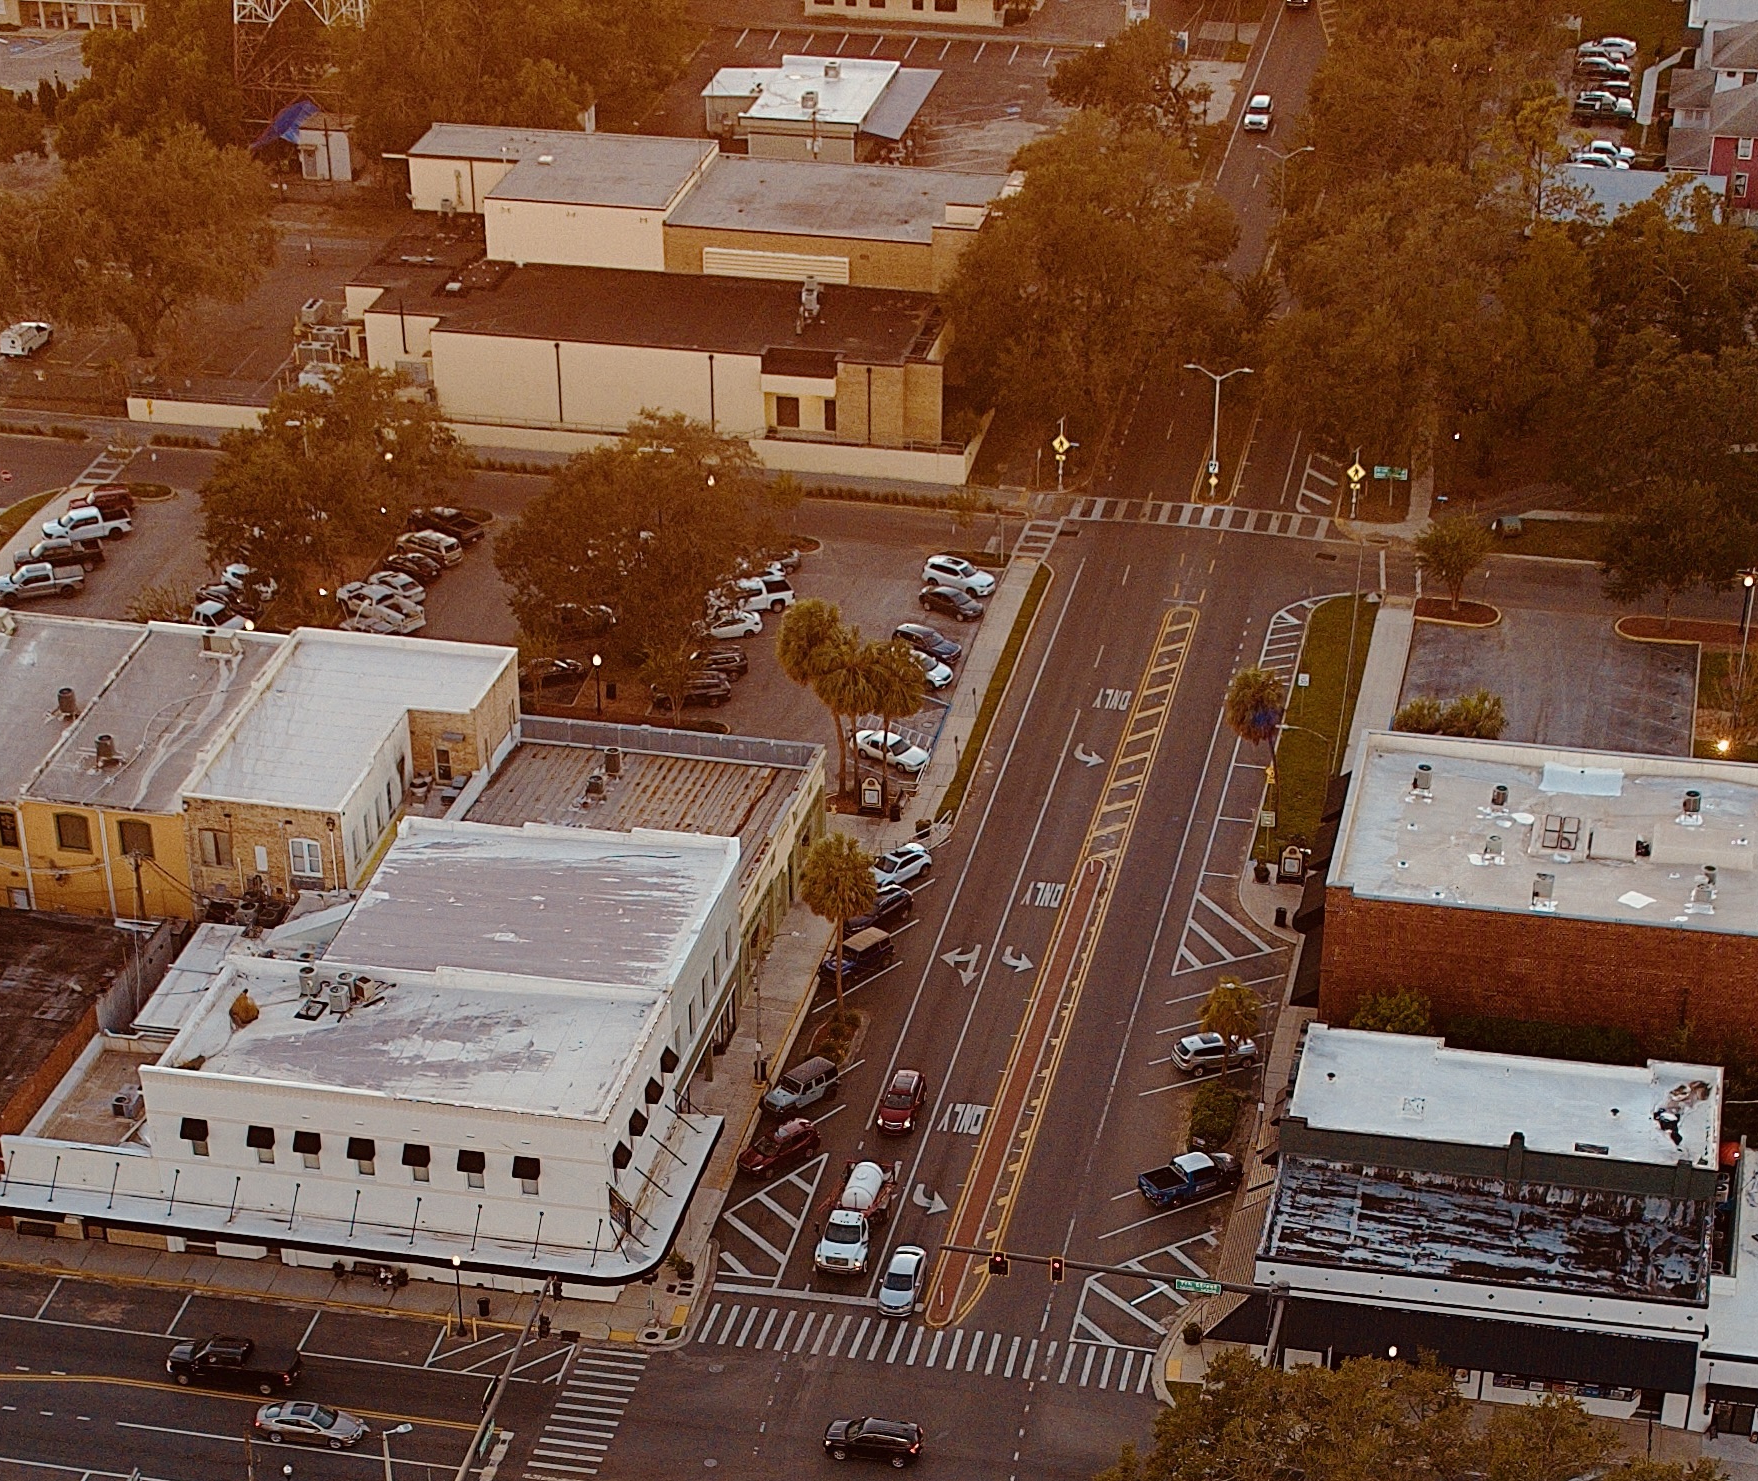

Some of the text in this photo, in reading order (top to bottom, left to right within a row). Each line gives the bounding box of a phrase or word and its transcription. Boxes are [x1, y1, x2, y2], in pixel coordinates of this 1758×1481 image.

[1092, 688, 1133, 711] ONLY
[1020, 881, 1066, 908] ONLY
[937, 1103, 990, 1135] ONLY
